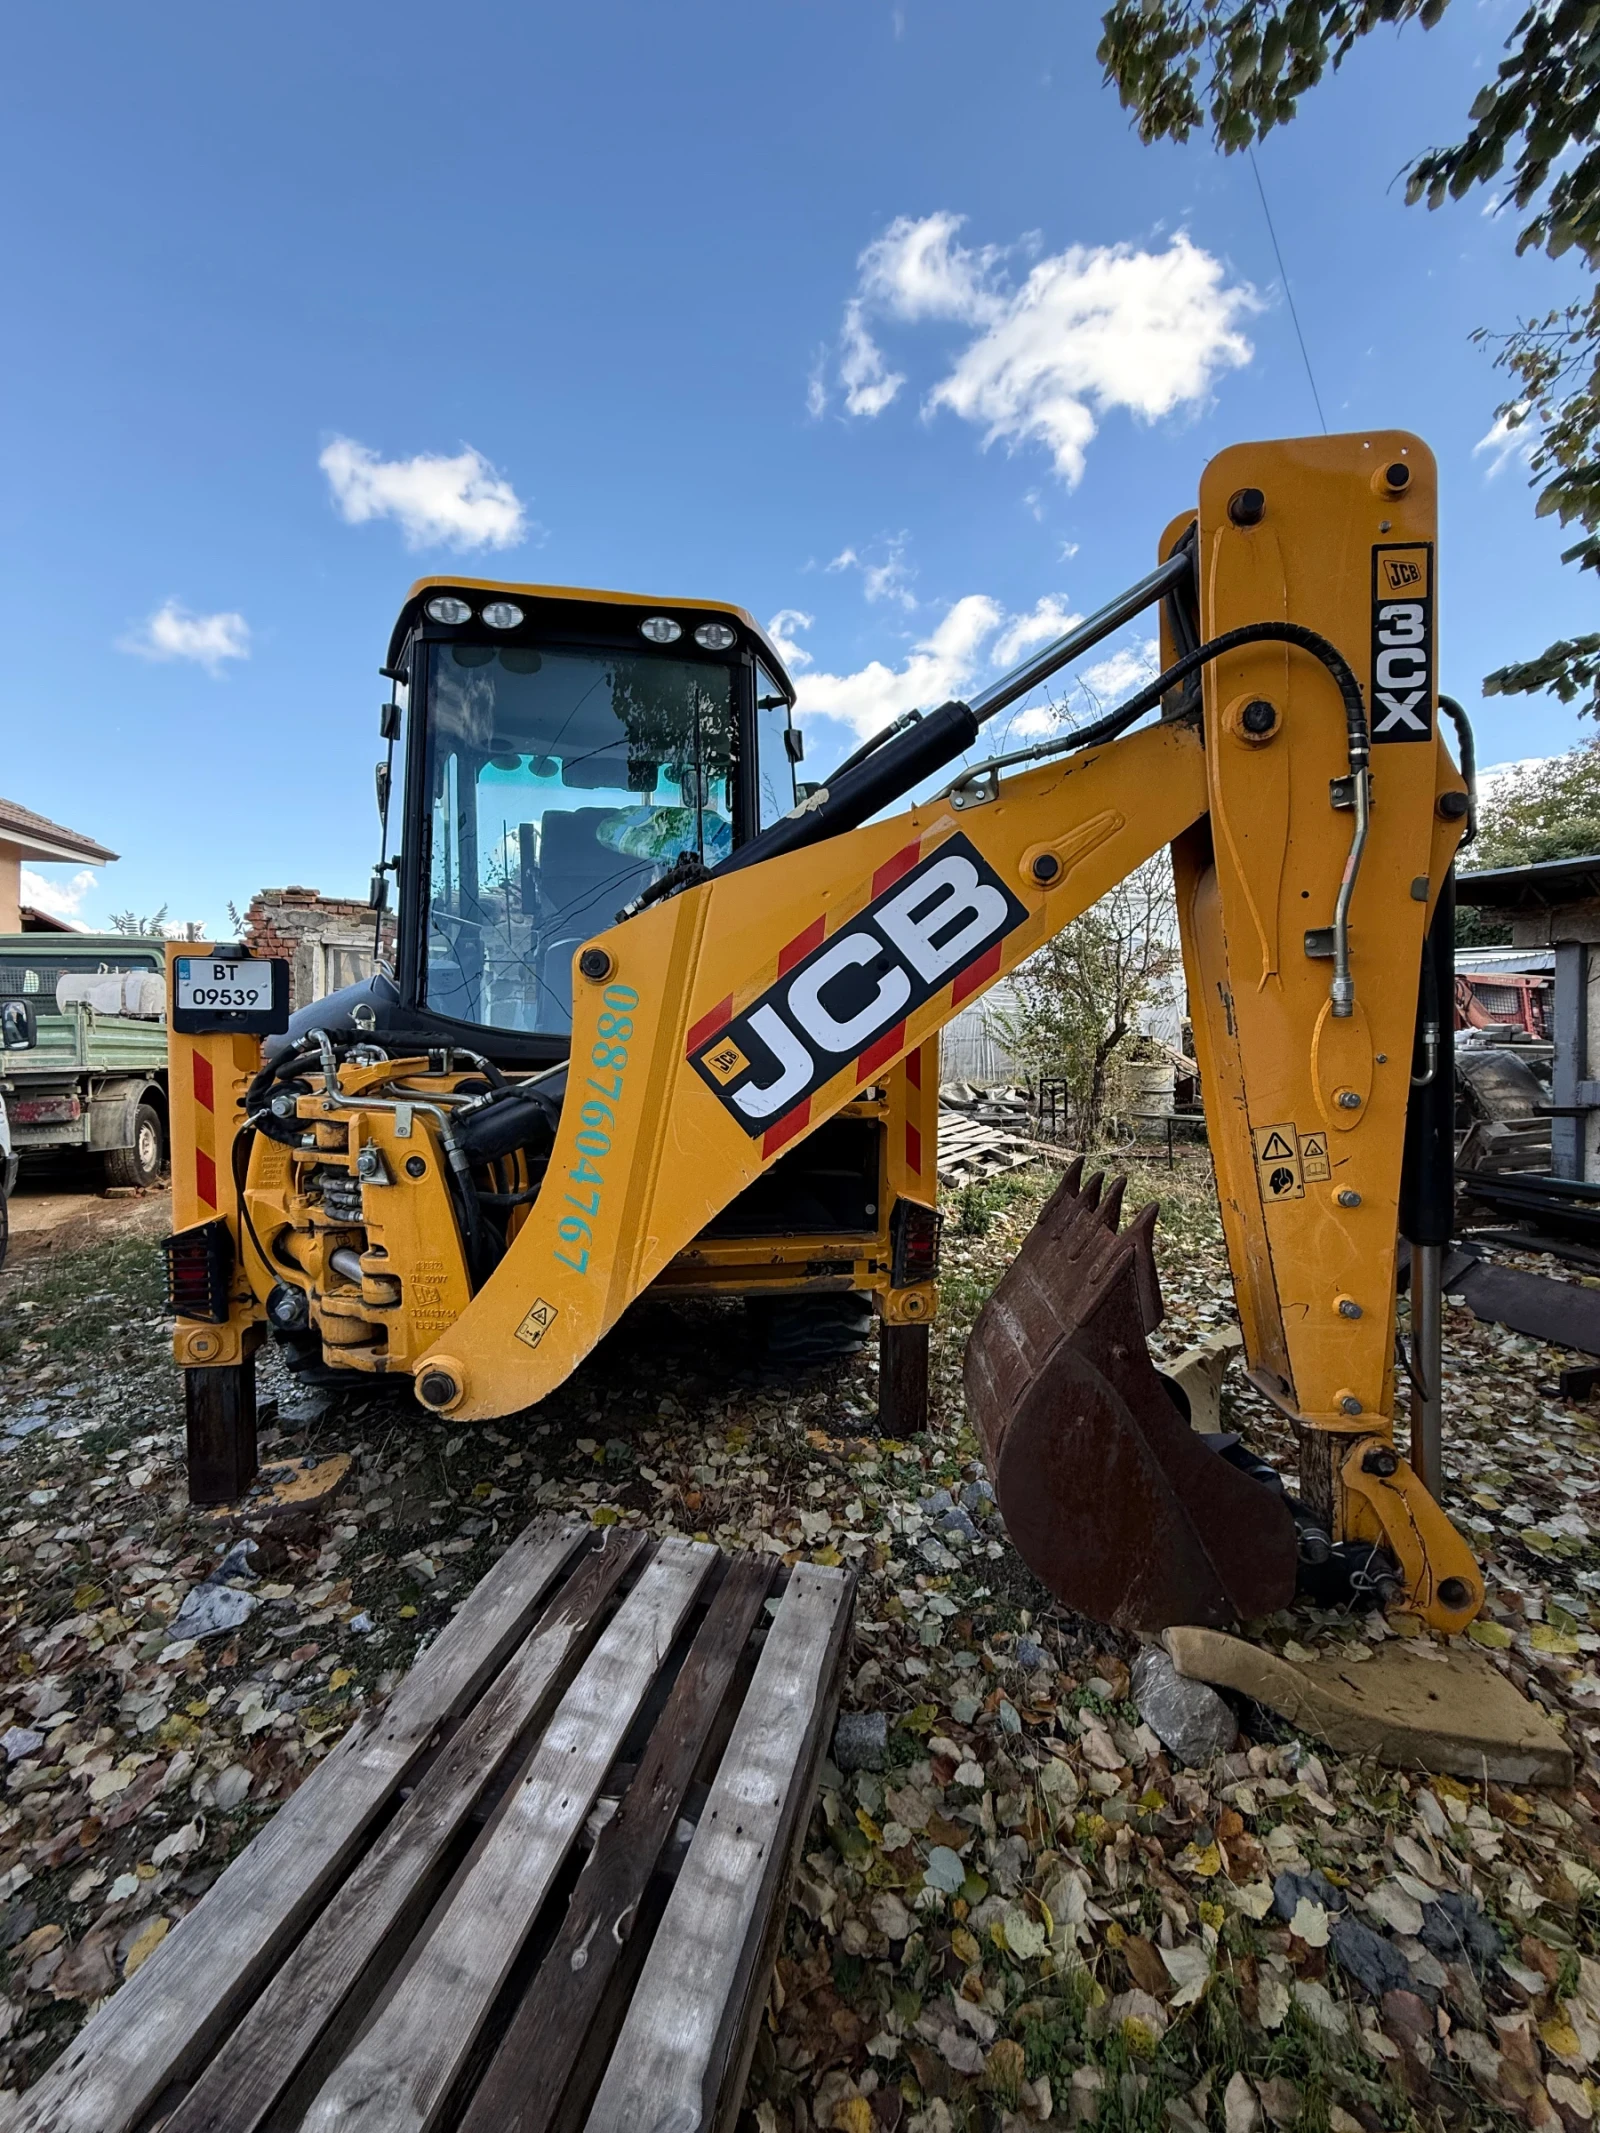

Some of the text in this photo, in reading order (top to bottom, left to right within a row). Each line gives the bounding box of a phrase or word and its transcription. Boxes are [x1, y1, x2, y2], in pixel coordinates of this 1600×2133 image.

[1390, 562, 1419, 587] JCB
[1373, 603, 1429, 732] 3CX
[179, 971, 190, 979] BG
[213, 964, 239, 981] BT
[193, 988, 259, 1006] 09539
[731, 855, 1009, 1118] JCB
[713, 1050, 737, 1072] JCB
[553, 984, 640, 1275] 0887604767
